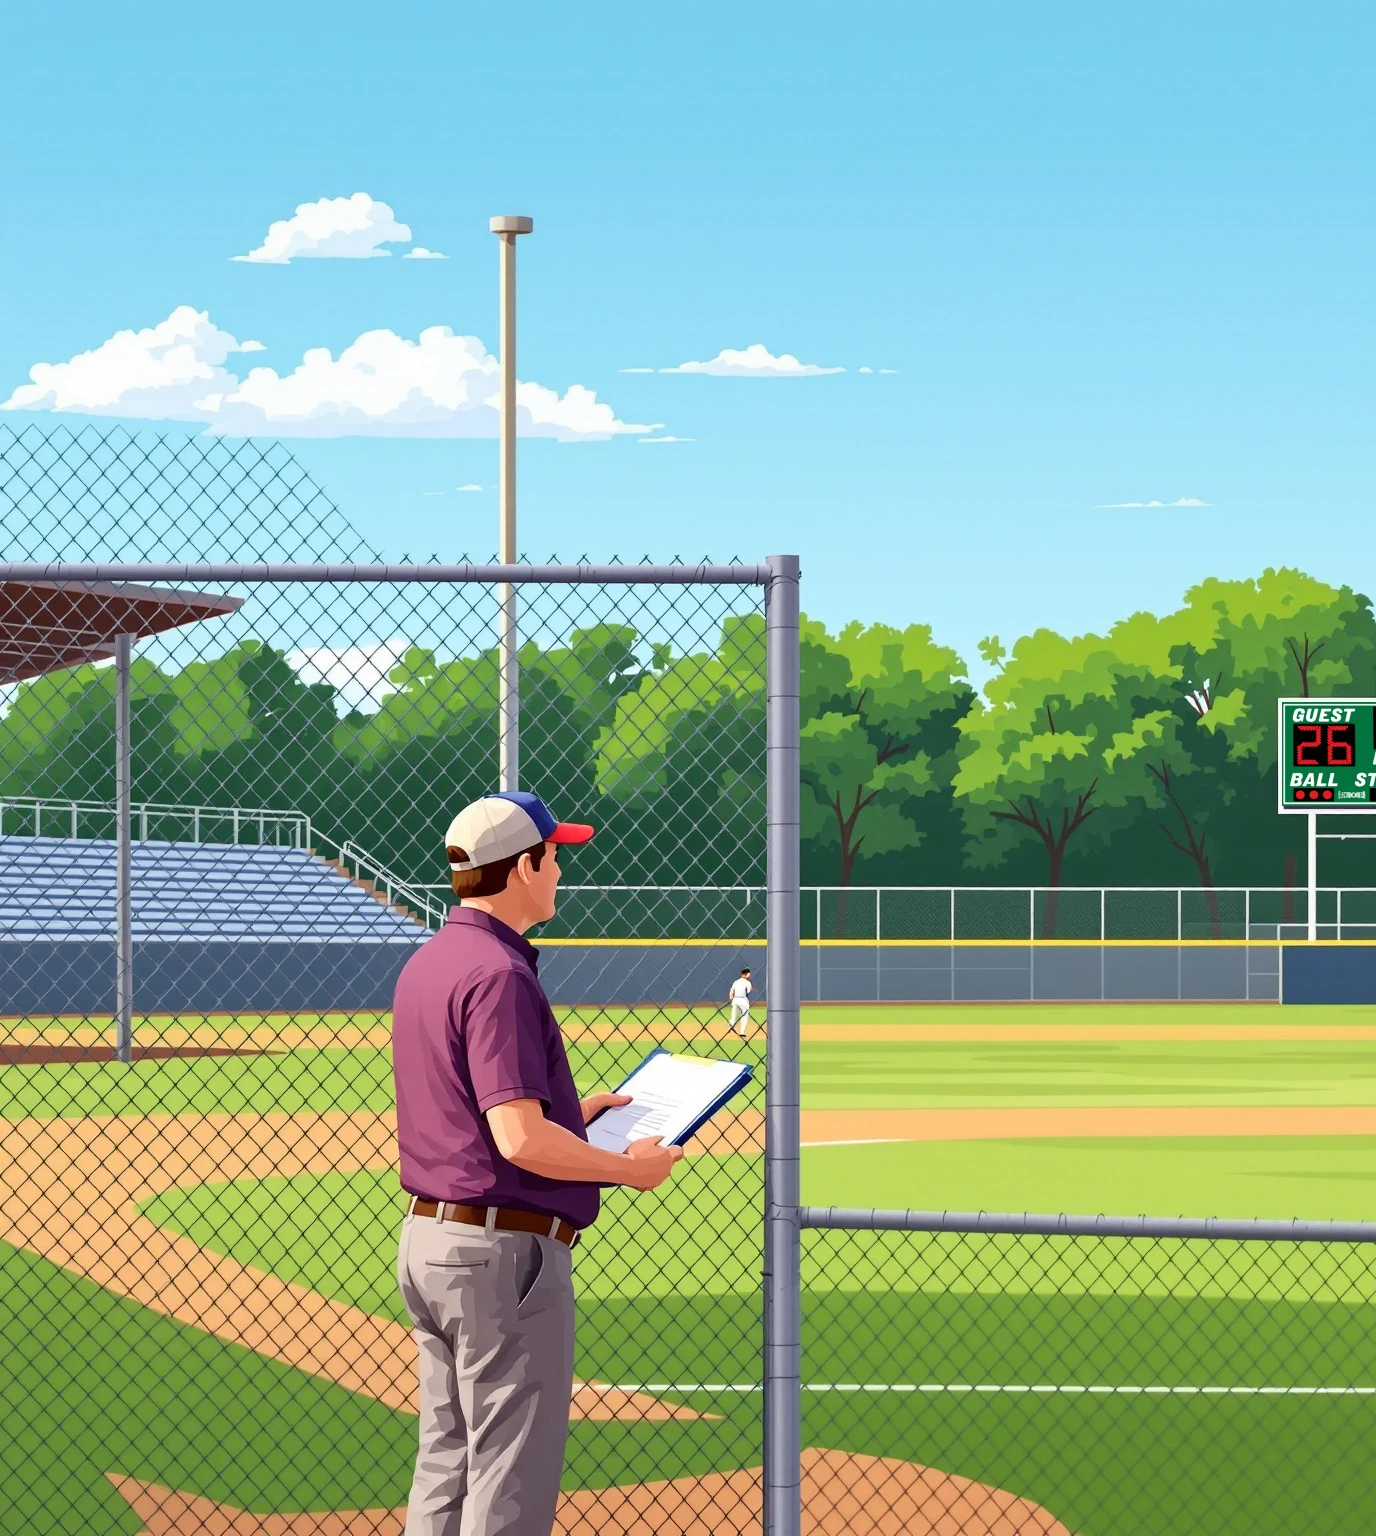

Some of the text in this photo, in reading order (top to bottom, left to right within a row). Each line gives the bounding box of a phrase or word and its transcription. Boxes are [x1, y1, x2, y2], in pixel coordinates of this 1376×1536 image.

[1292, 708, 1356, 723] GUEST
[1297, 725, 1352, 765] 26
[1289, 772, 1339, 787] BALL
